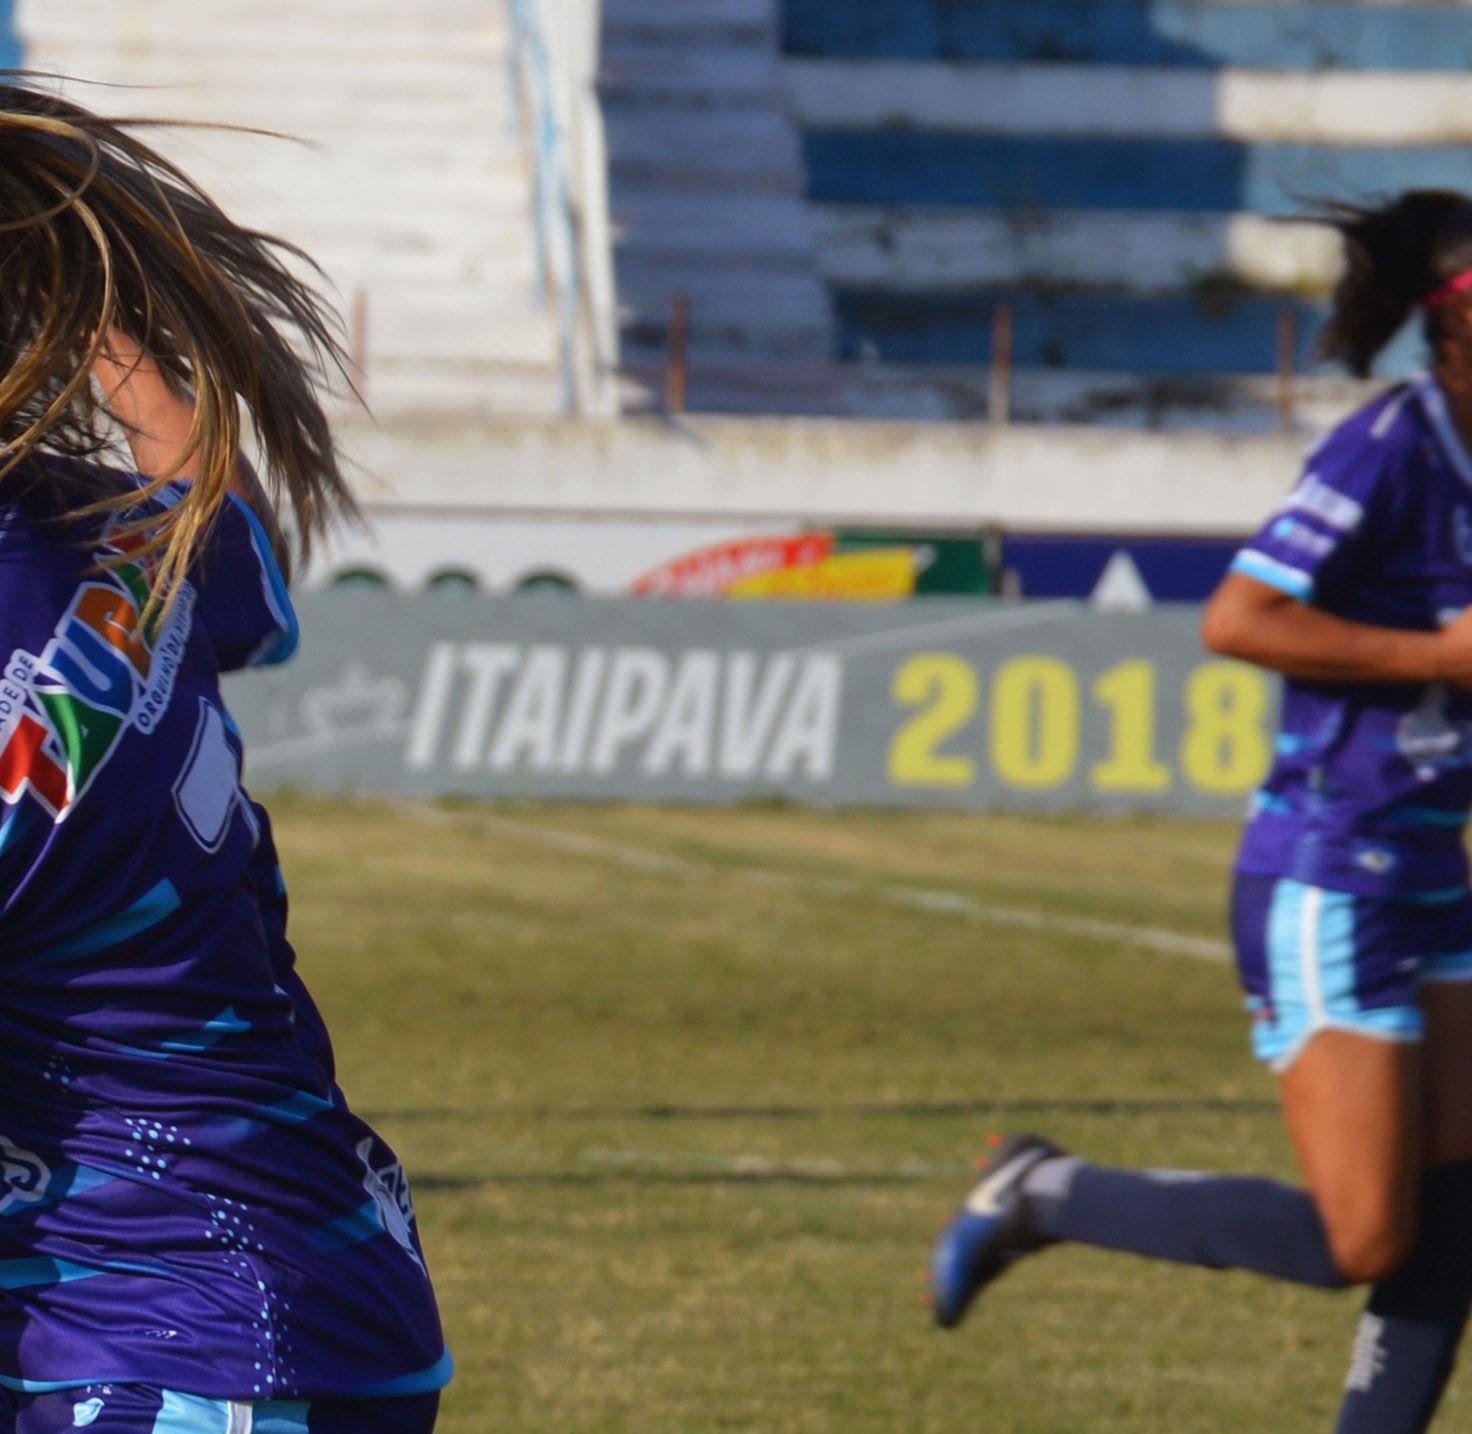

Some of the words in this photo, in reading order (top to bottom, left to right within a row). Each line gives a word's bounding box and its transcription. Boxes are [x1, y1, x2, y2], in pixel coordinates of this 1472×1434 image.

[11, 653, 35, 683] DE
[406, 643, 844, 779] ITAIPAVA
[887, 652, 1274, 794] 2018
